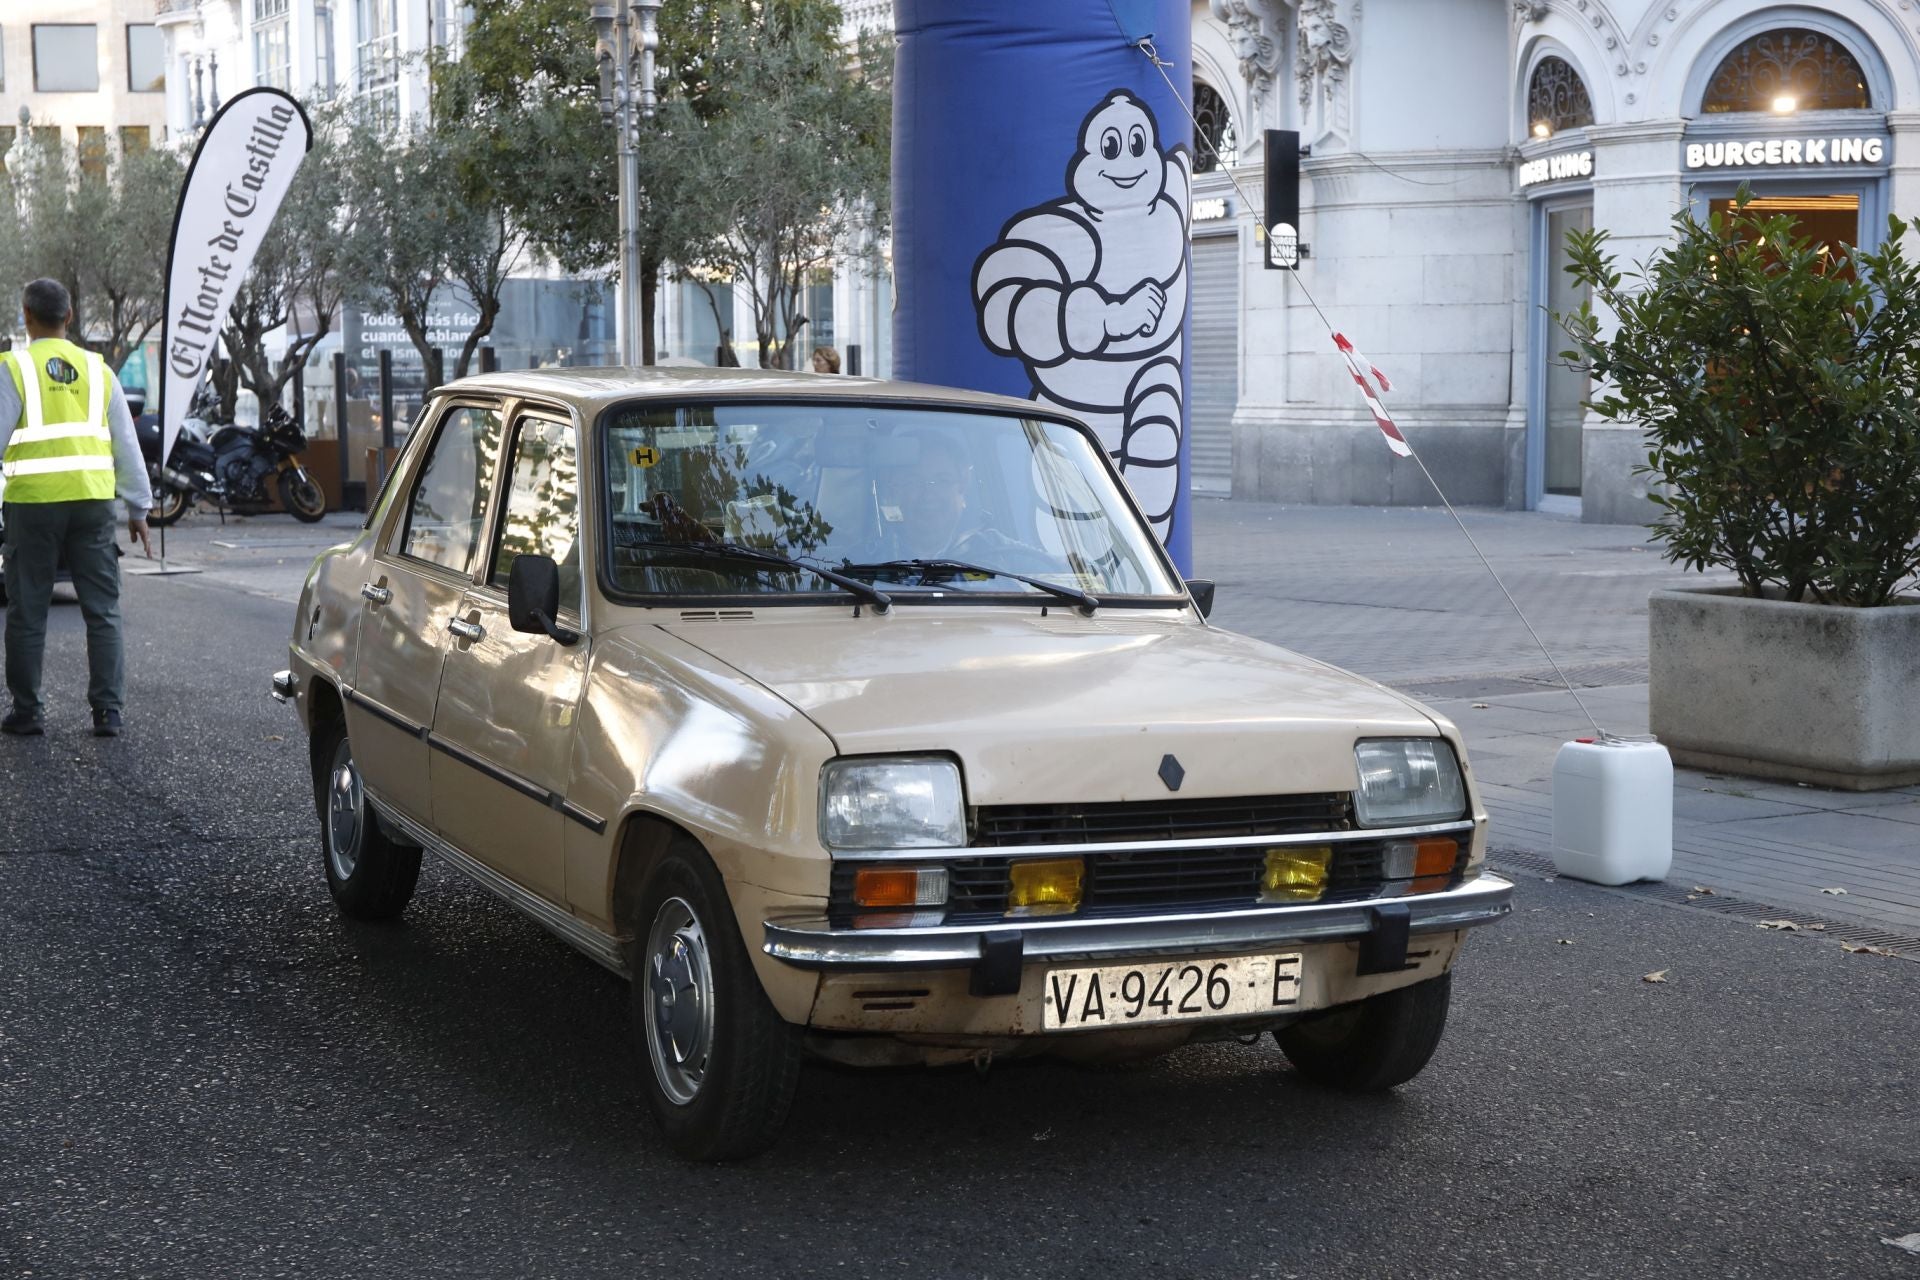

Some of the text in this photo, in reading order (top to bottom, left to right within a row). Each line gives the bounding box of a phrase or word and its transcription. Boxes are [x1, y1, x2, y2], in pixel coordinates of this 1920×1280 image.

[1550, 151, 1592, 179] KING
[1687, 140, 1802, 168] BURGER
[170, 103, 295, 379] El Norte de Castilla
[361, 345, 376, 359] el
[635, 448, 653, 465] H
